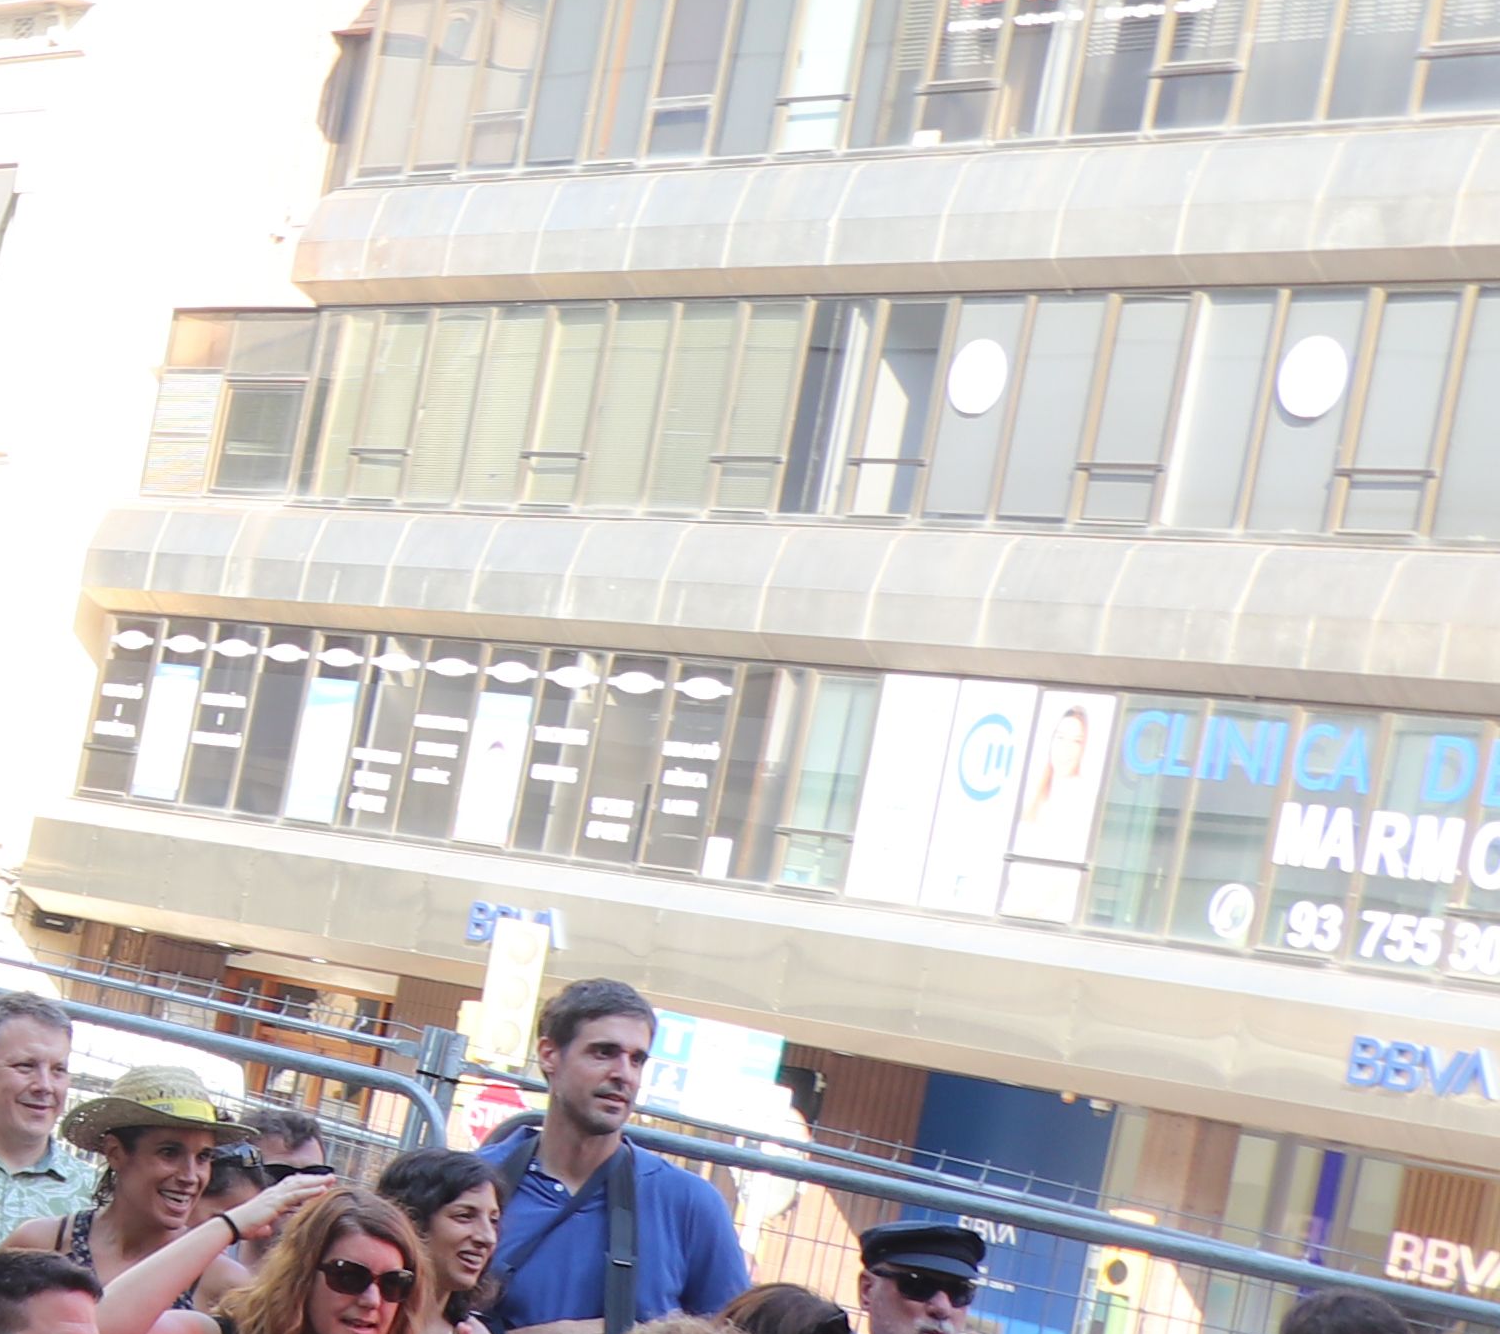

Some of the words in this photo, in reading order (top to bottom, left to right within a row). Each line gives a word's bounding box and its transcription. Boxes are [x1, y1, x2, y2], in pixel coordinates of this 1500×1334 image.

[1121, 710, 1371, 795] CLINICA
[1286, 900, 1344, 952] 93
[1358, 910, 1446, 966] 755
[1346, 1034, 1500, 1100] BBVA
[1385, 1230, 1500, 1294] BBV
